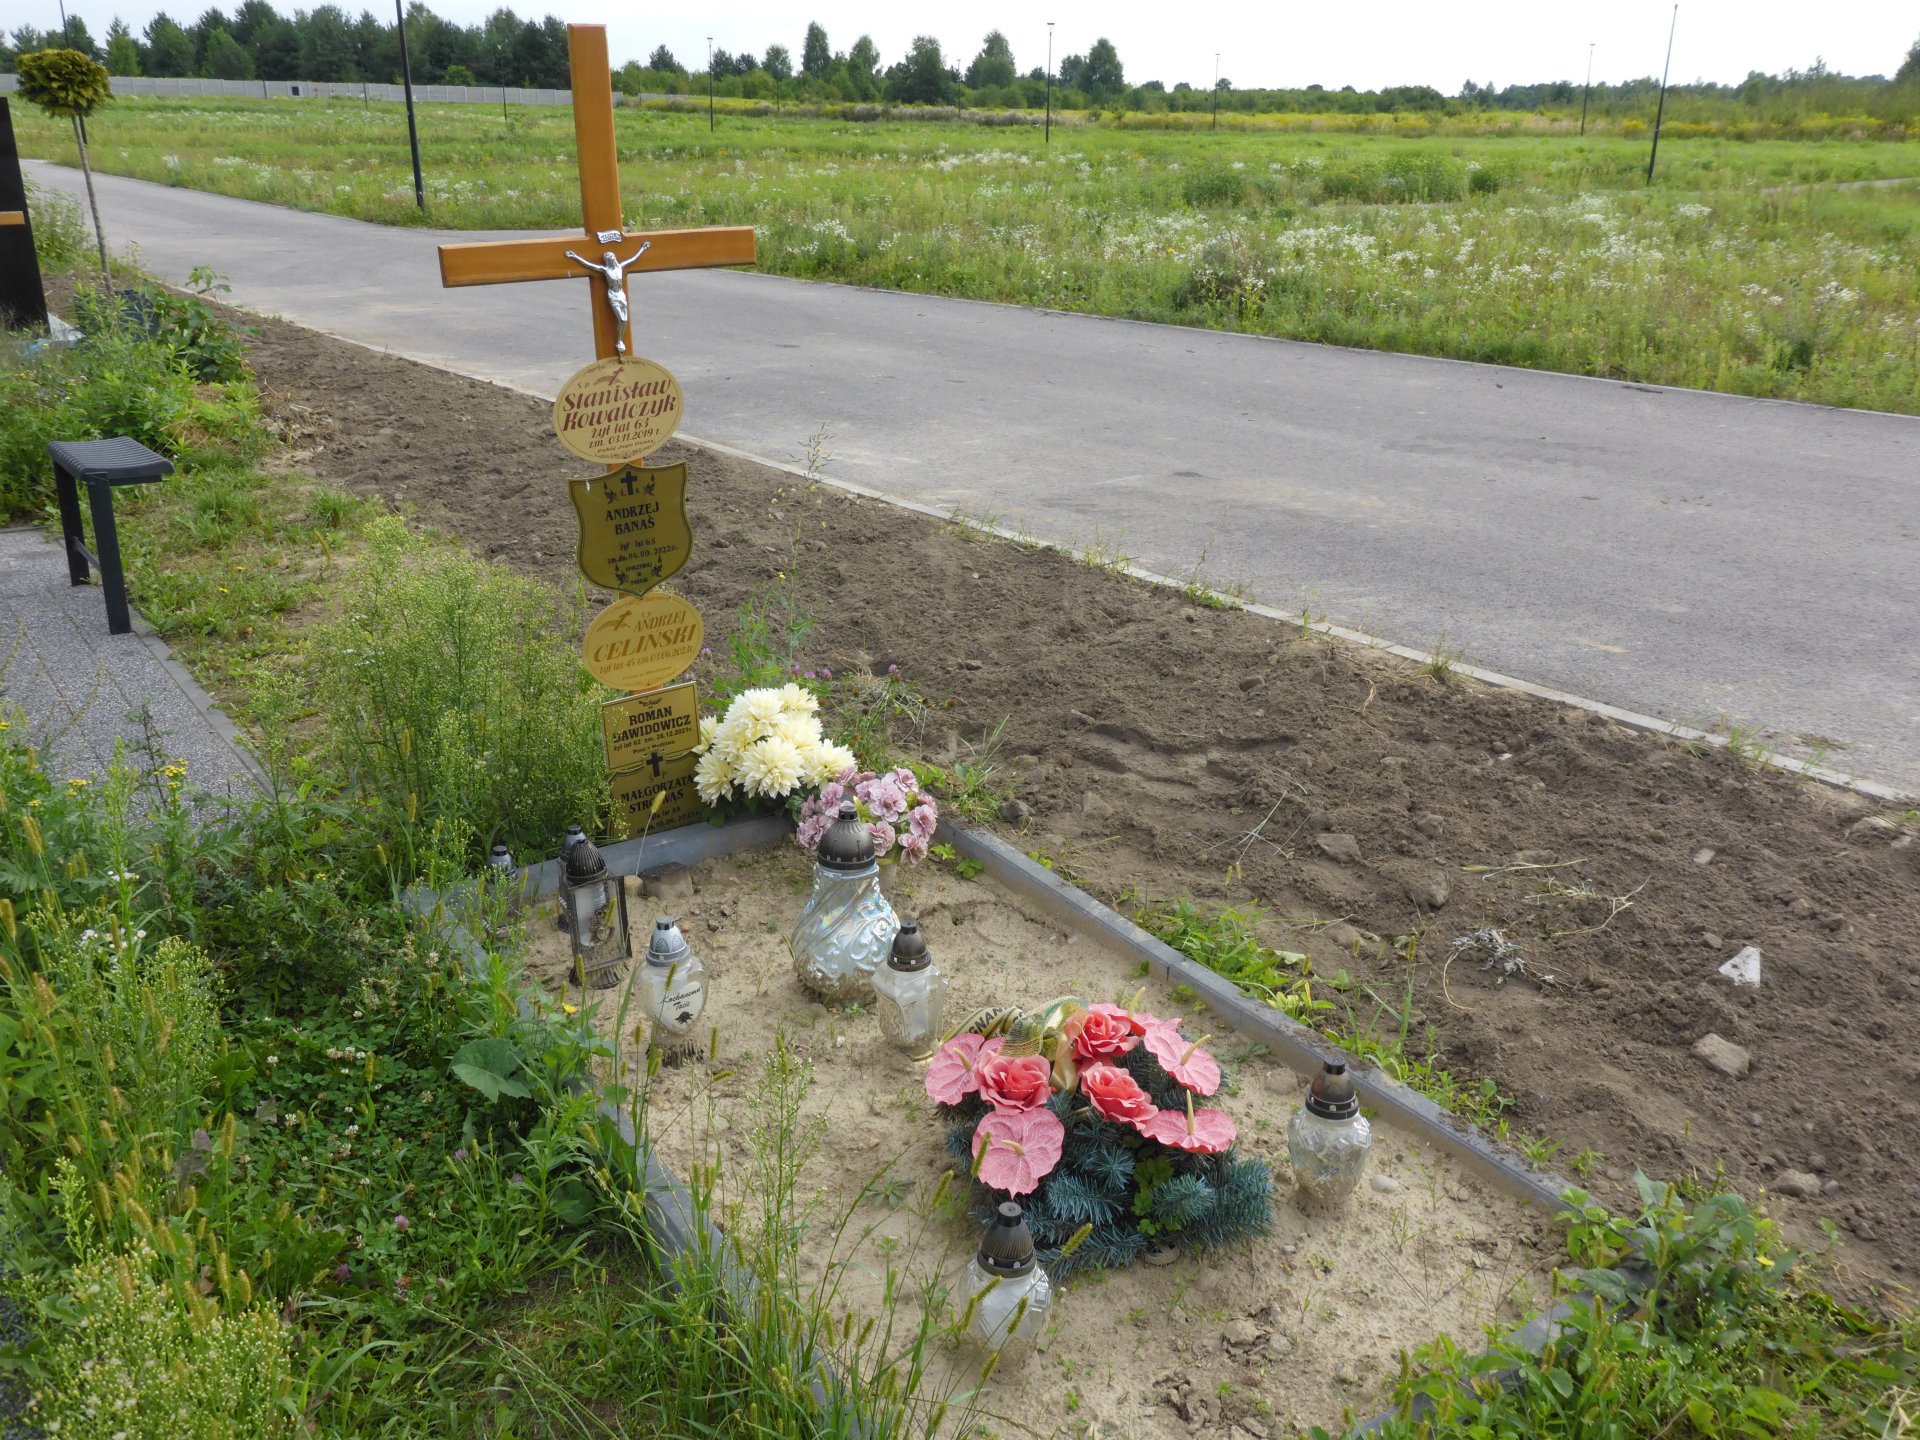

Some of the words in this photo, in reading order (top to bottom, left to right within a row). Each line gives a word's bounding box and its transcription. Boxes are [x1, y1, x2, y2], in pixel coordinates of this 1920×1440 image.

[563, 380, 671, 411] Stanisław
[563, 395, 676, 431] Kowalczyk
[614, 421, 630, 433] lat
[634, 417, 649, 430] 63
[605, 501, 659, 521] ANDRZEJ
[615, 515, 655, 535] BANAŚ
[633, 610, 686, 632] ANDRZEJ
[628, 706, 672, 726] ROMAN
[624, 741, 632, 749] lat
[620, 773, 695, 803] MAŁGORZATA
